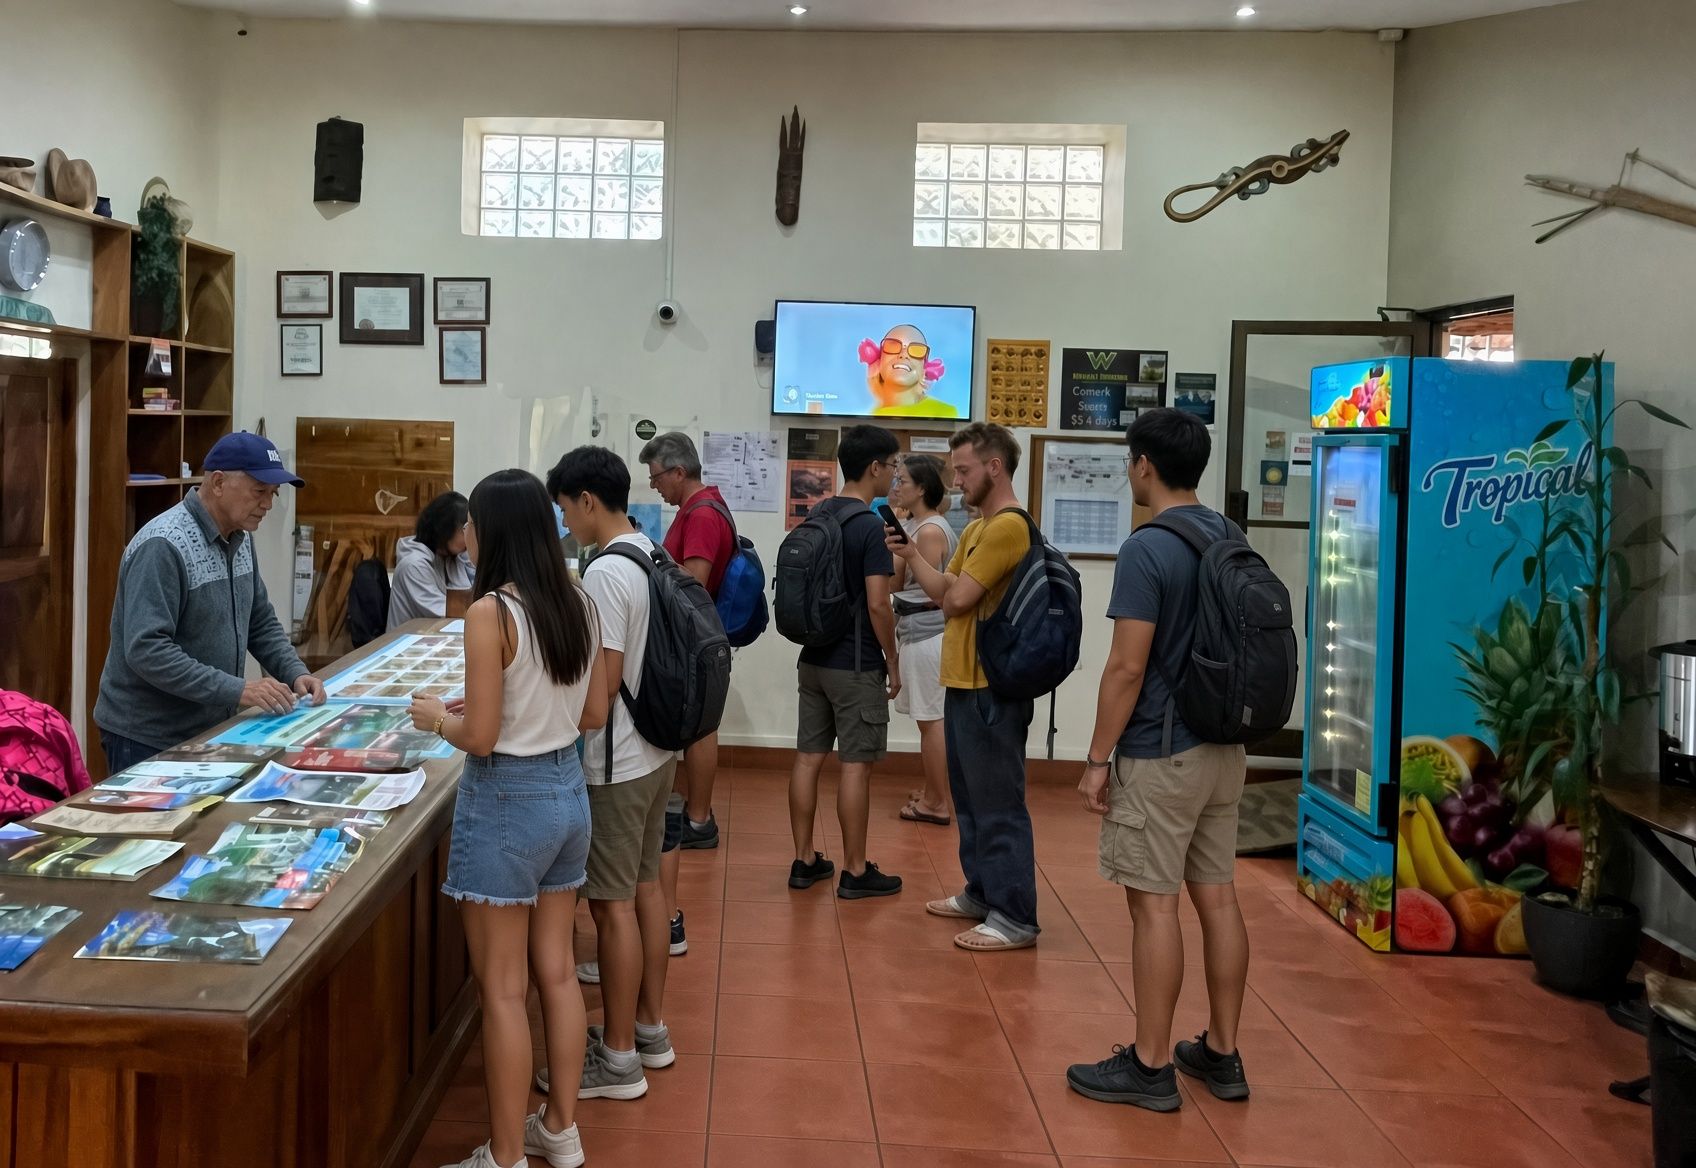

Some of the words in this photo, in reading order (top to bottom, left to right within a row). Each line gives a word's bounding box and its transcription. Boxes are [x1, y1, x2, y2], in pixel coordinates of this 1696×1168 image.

[1086, 352, 1117, 370] W
[1095, 415, 1117, 427] days
[1422, 440, 1594, 528] Tropical
